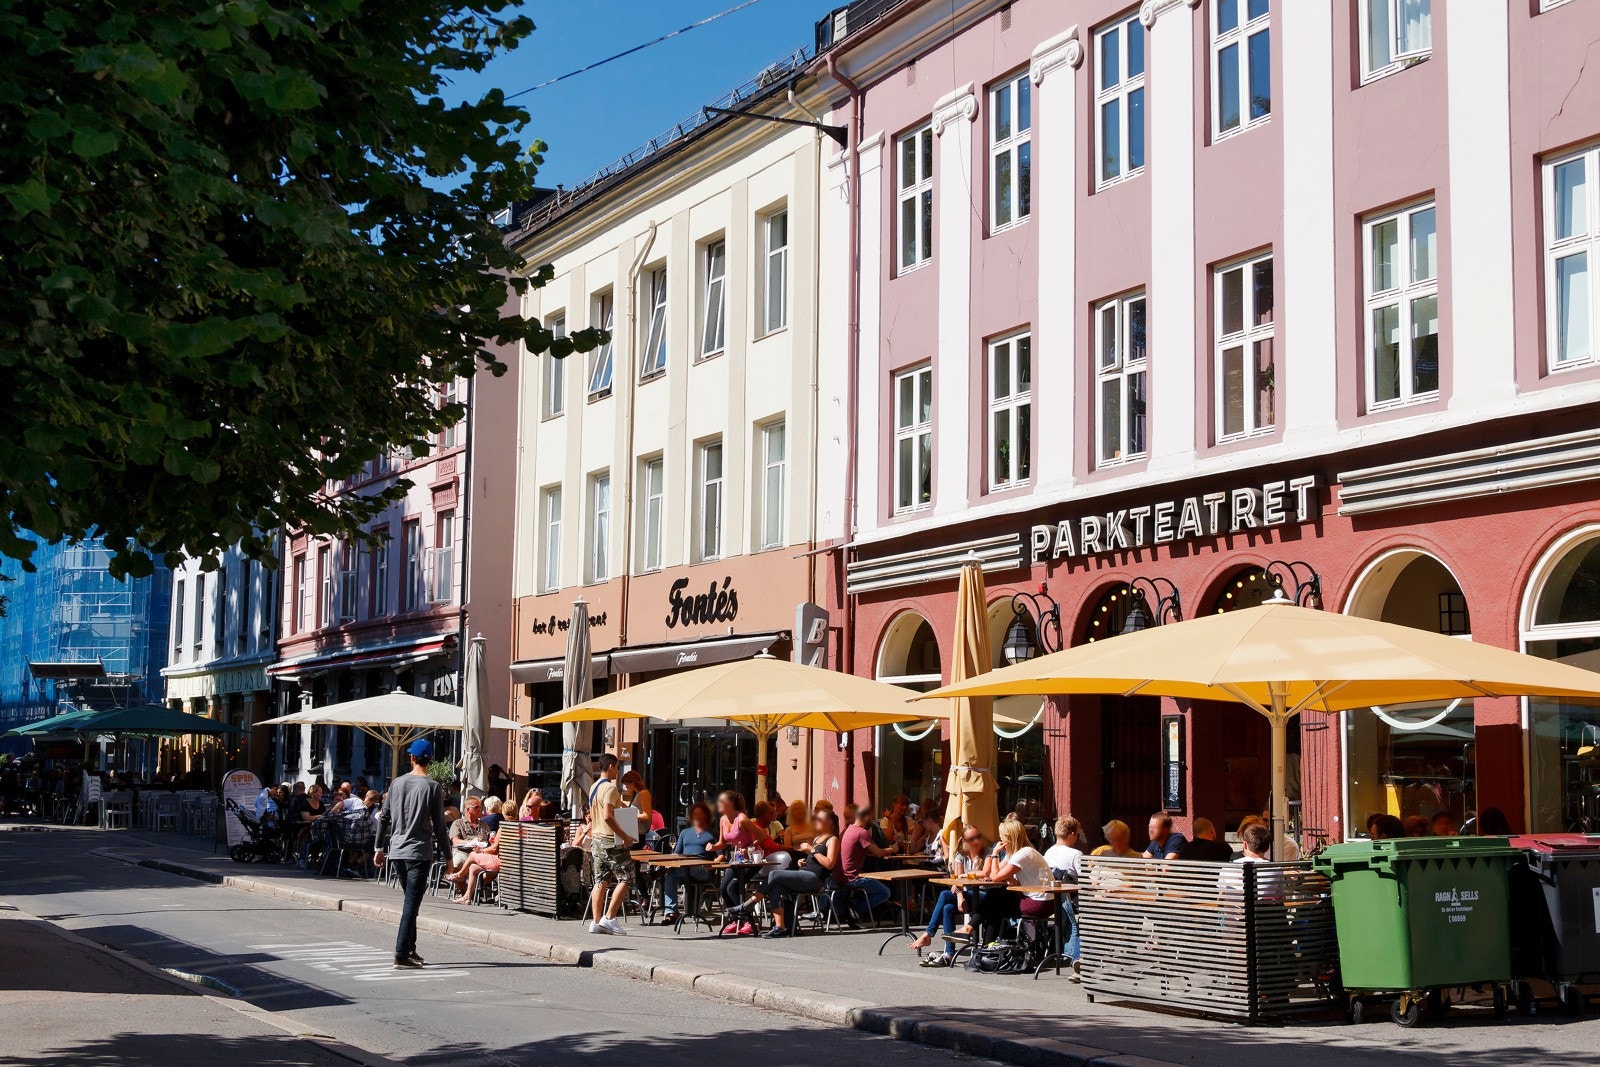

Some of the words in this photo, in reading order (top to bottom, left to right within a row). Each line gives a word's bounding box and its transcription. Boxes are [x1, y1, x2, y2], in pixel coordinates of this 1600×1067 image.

[1030, 475, 1315, 562] PARKTEATRET
[665, 575, 739, 629] Fontés
[1460, 890, 1479, 901] SELLS
